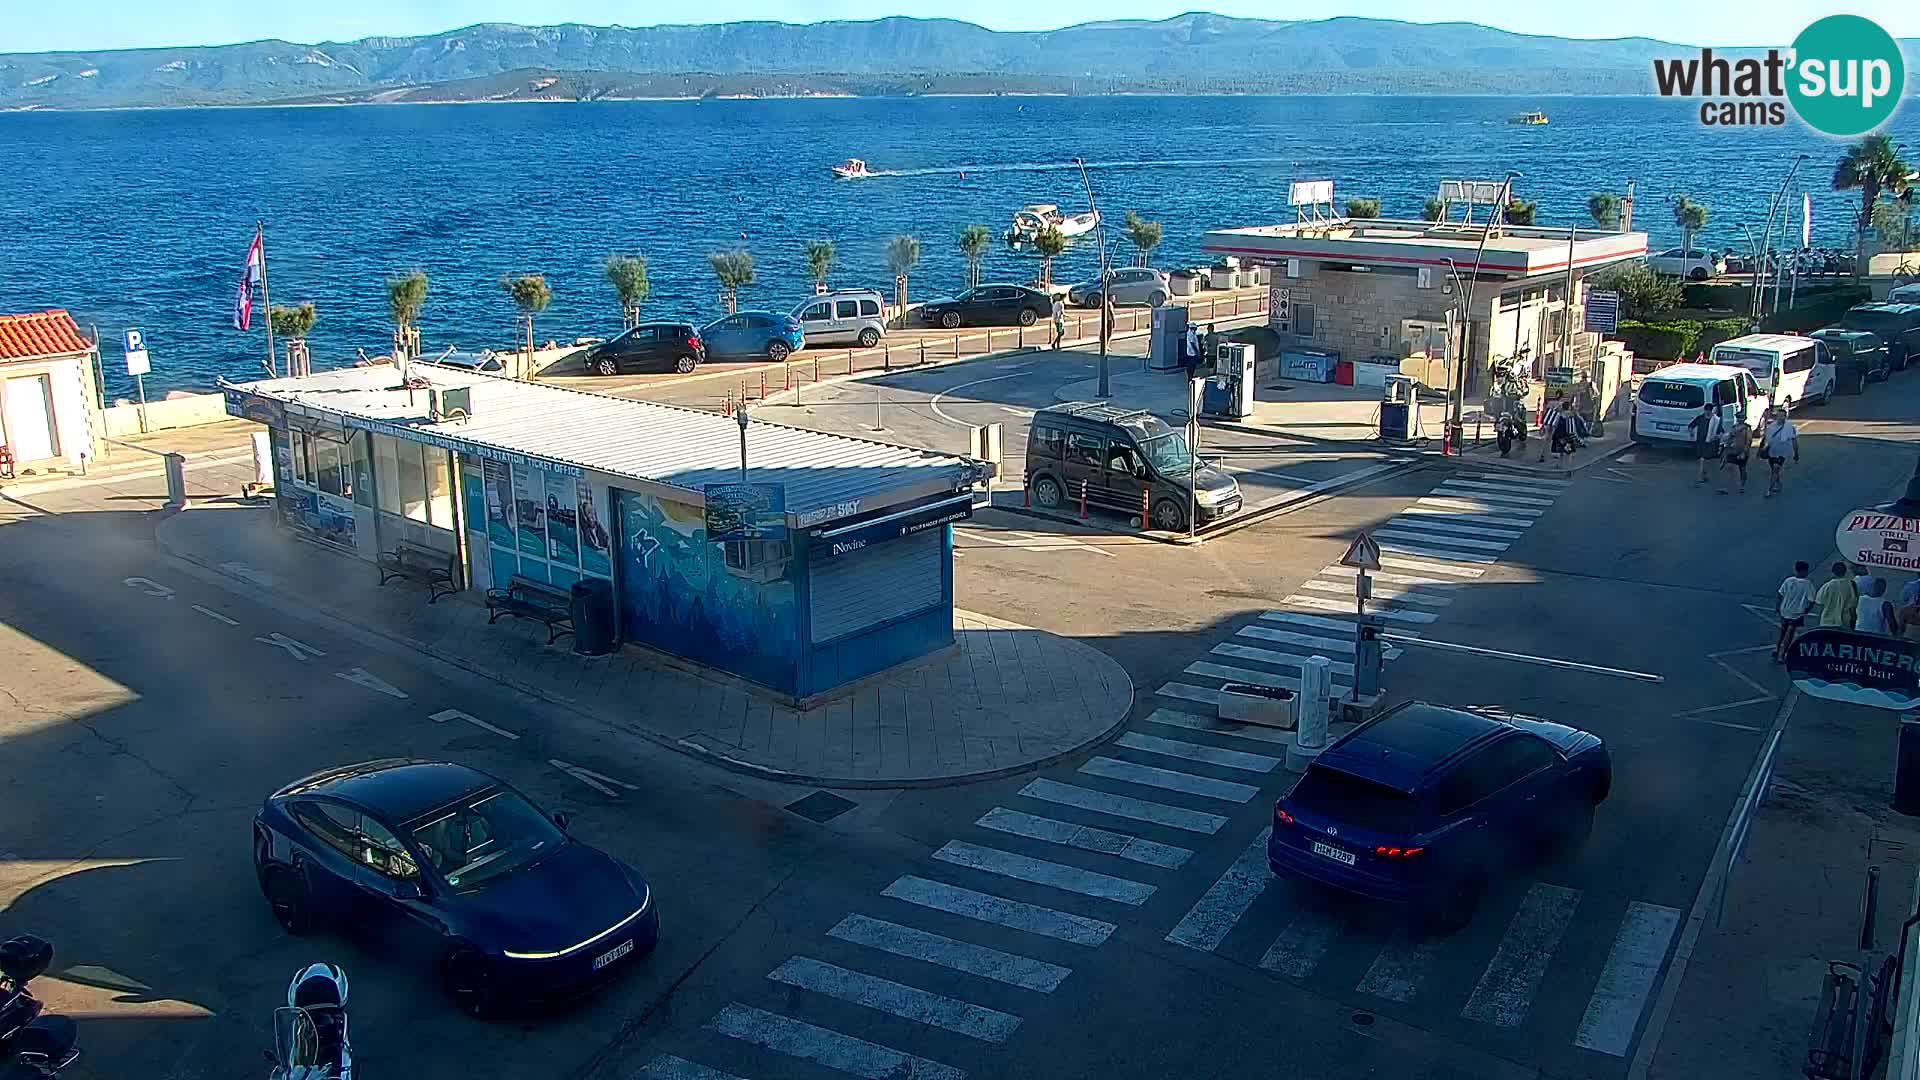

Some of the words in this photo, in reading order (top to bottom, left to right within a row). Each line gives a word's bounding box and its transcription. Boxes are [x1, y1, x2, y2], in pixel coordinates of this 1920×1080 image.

[128, 331, 141, 350] P
[1720, 352, 1736, 360] TAXI
[1664, 383, 1683, 391] TAXI
[477, 446, 491, 458] BUS
[493, 448, 524, 465] STATION
[527, 456, 553, 471] TICKET
[554, 463, 580, 477] OFFICE
[1880, 531, 1914, 540] GRILL
[1827, 662, 1863, 675] caffe
[1869, 665, 1896, 680] bar
